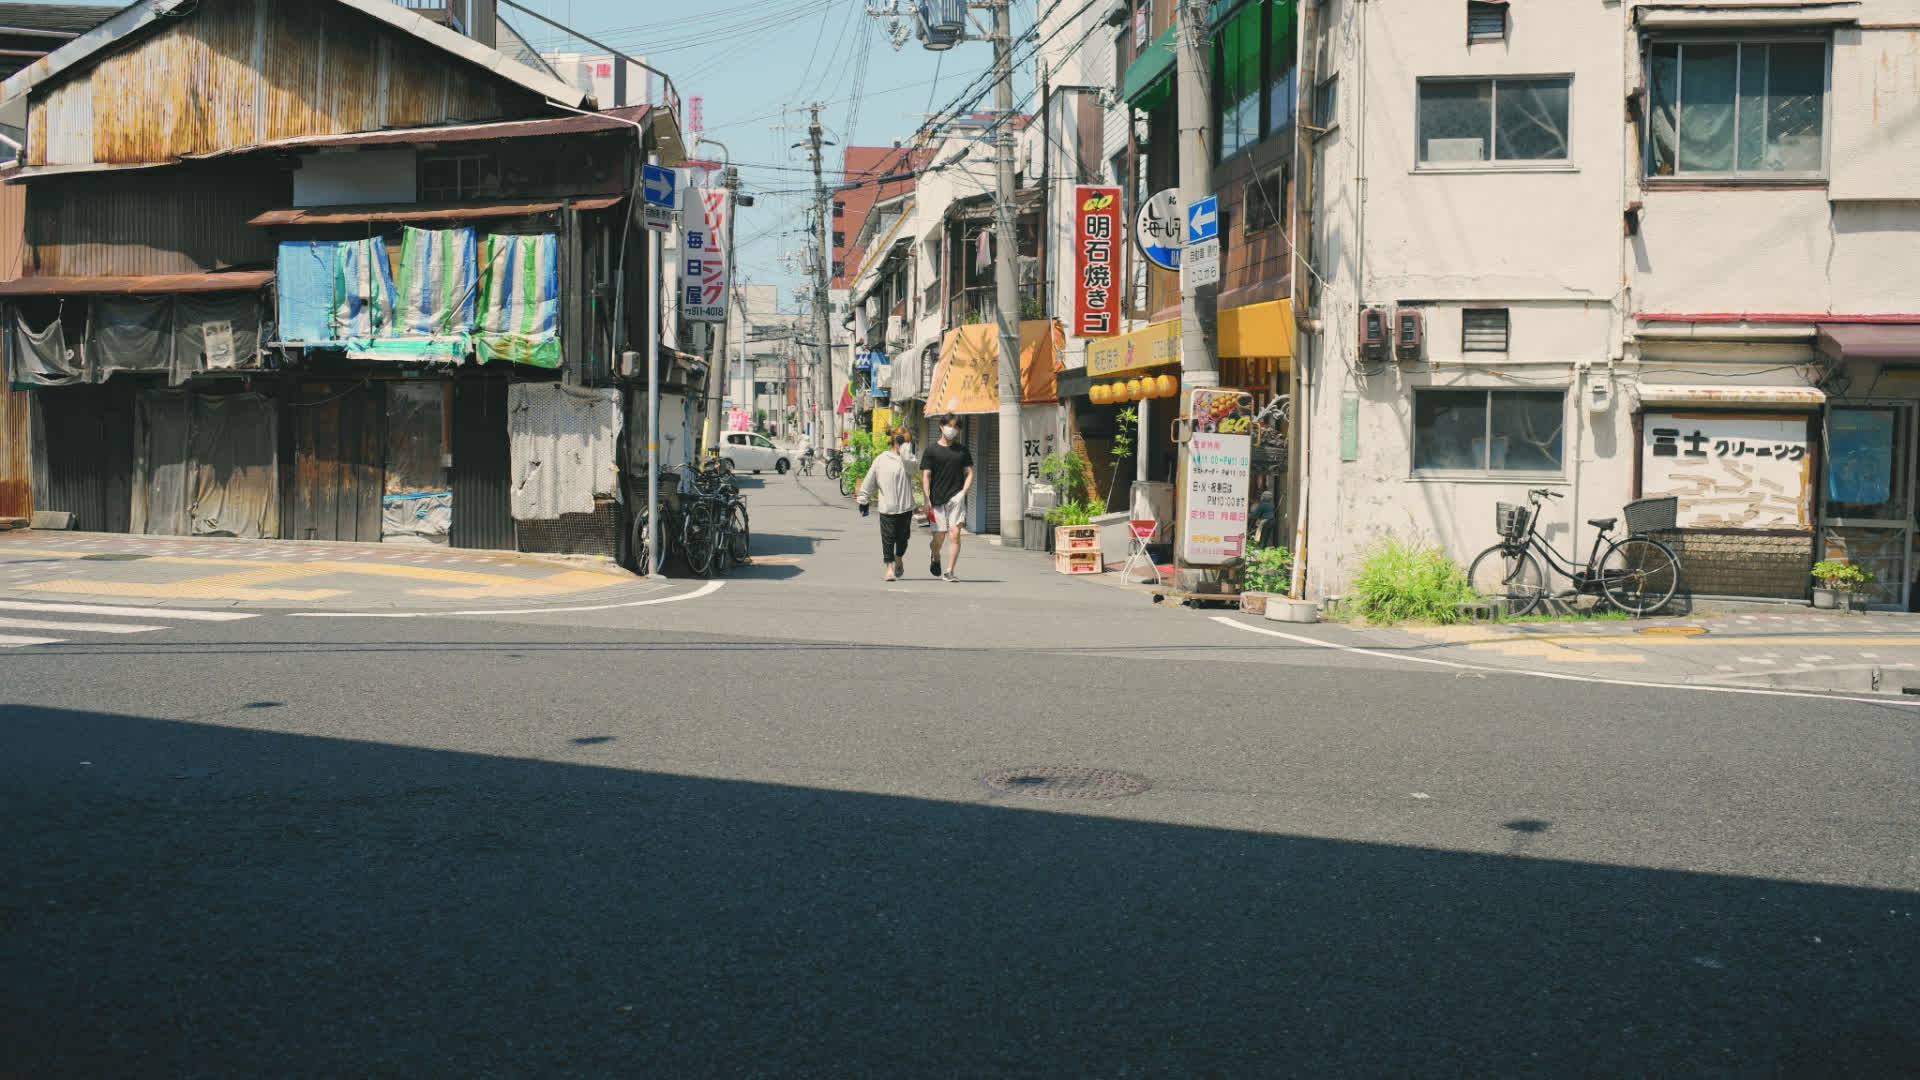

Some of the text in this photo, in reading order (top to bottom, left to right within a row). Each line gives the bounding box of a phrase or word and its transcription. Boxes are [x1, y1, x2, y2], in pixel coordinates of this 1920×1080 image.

[686, 230, 703, 305] 毎日屋
[702, 193, 725, 305] クリーニング
